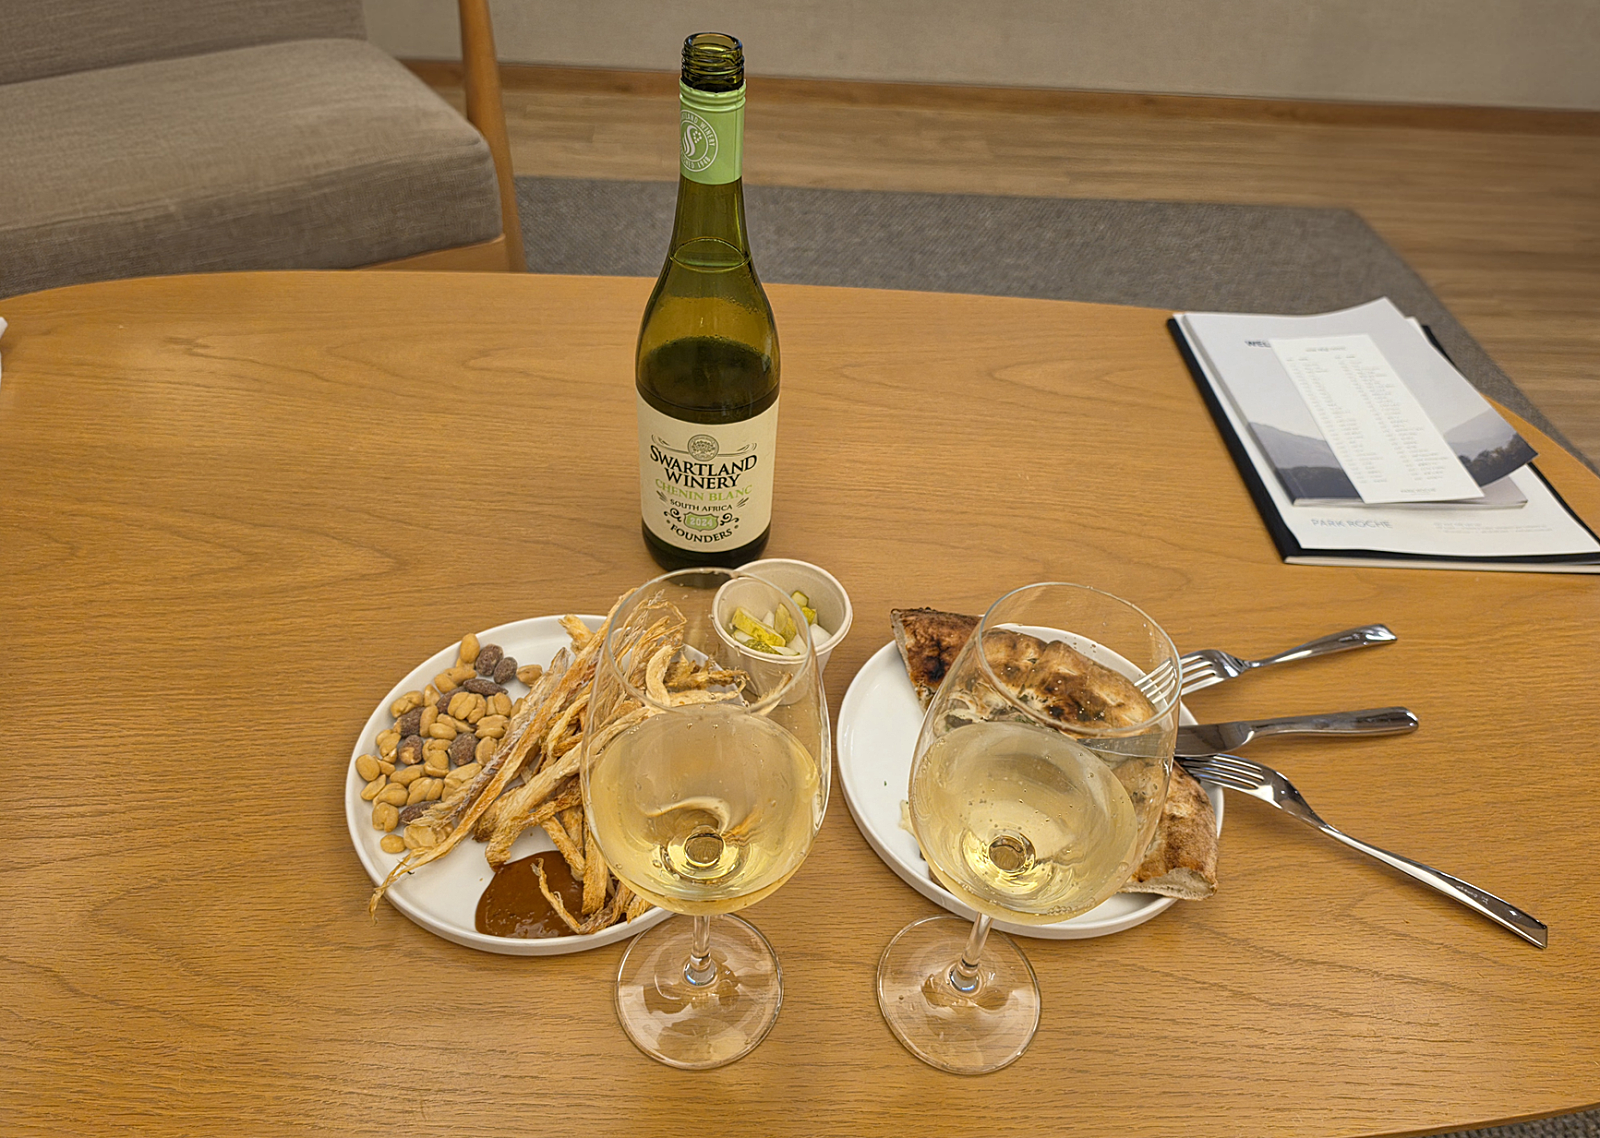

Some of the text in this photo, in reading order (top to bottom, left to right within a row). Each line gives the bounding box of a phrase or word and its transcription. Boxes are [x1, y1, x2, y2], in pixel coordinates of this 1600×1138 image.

[700, 122, 716, 147] WINERY
[650, 445, 757, 477] SWARTLAND
[664, 467, 741, 489] WINERY
[655, 479, 752, 501] CHENIN BLANC
[670, 499, 732, 512] SOUTH AFRICA
[689, 517, 713, 527] 2024
[1310, 518, 1394, 529] PARK ROCHE
[670, 524, 732, 543] FOUNDERS
